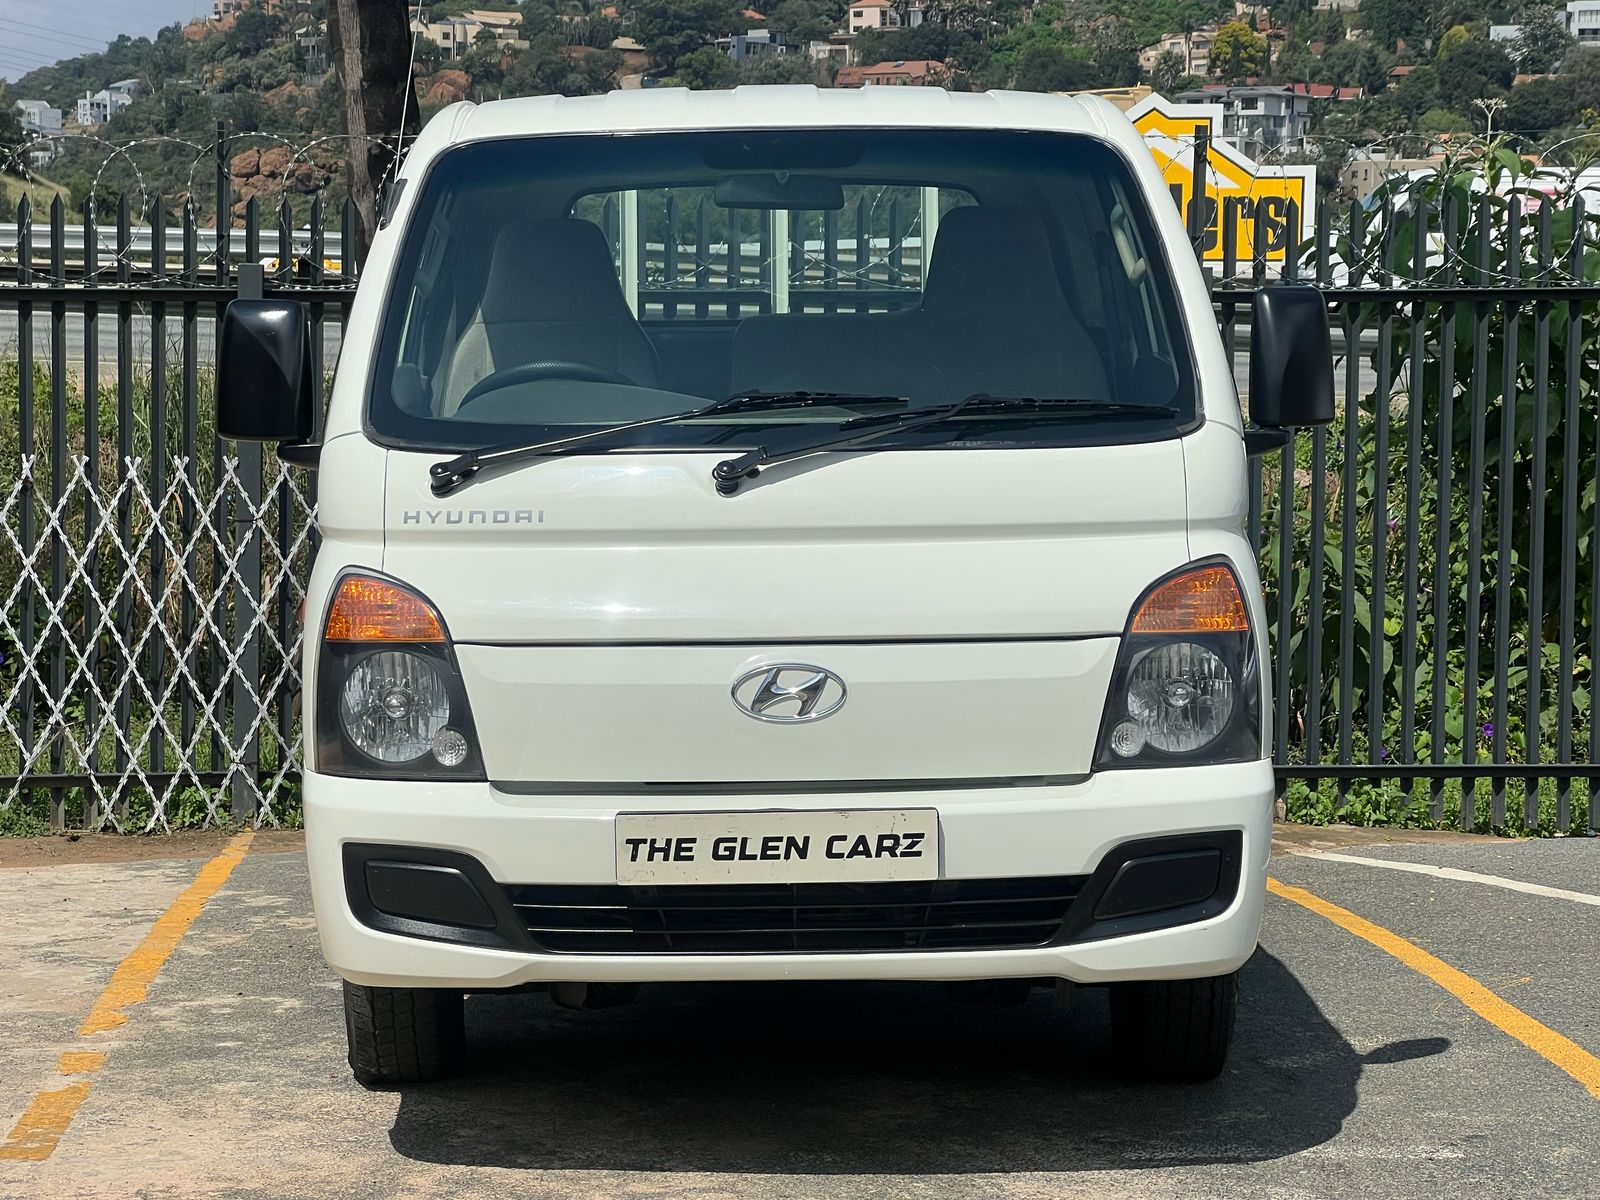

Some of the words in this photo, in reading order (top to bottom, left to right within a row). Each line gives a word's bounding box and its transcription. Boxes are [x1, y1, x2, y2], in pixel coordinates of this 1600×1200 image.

[403, 510, 544, 524] HYUNDAI
[625, 837, 697, 862] THE
[711, 835, 810, 861] GLEN
[825, 832, 925, 859] CARZ
